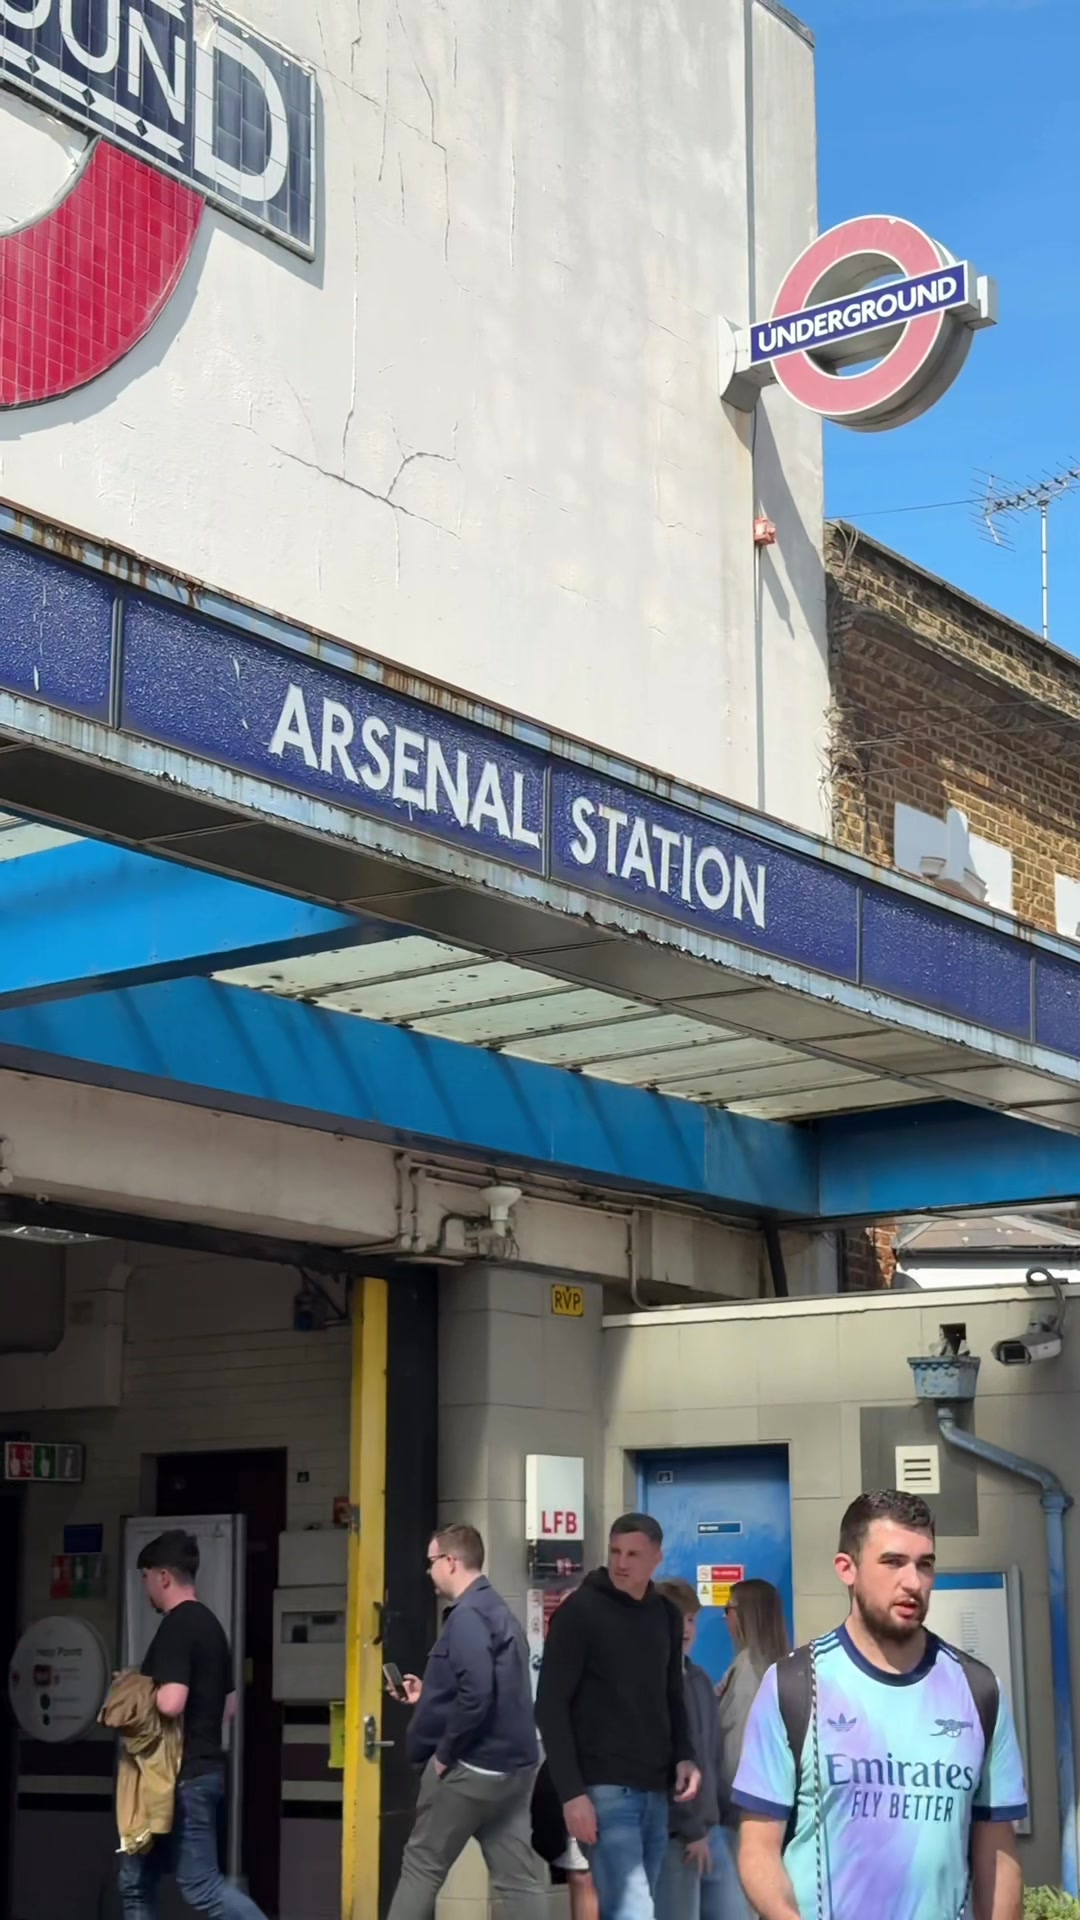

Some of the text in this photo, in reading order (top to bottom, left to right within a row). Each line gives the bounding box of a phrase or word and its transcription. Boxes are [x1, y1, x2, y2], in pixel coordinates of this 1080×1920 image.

[758, 276, 957, 352] UNDERGROUND
[268, 683, 766, 929] ARSENAL STATION
[554, 1290, 582, 1311] RVP
[541, 1510, 577, 1534] LFB
[825, 1752, 974, 1792] Emirates
[851, 1791, 954, 1823] FLY BETTER
